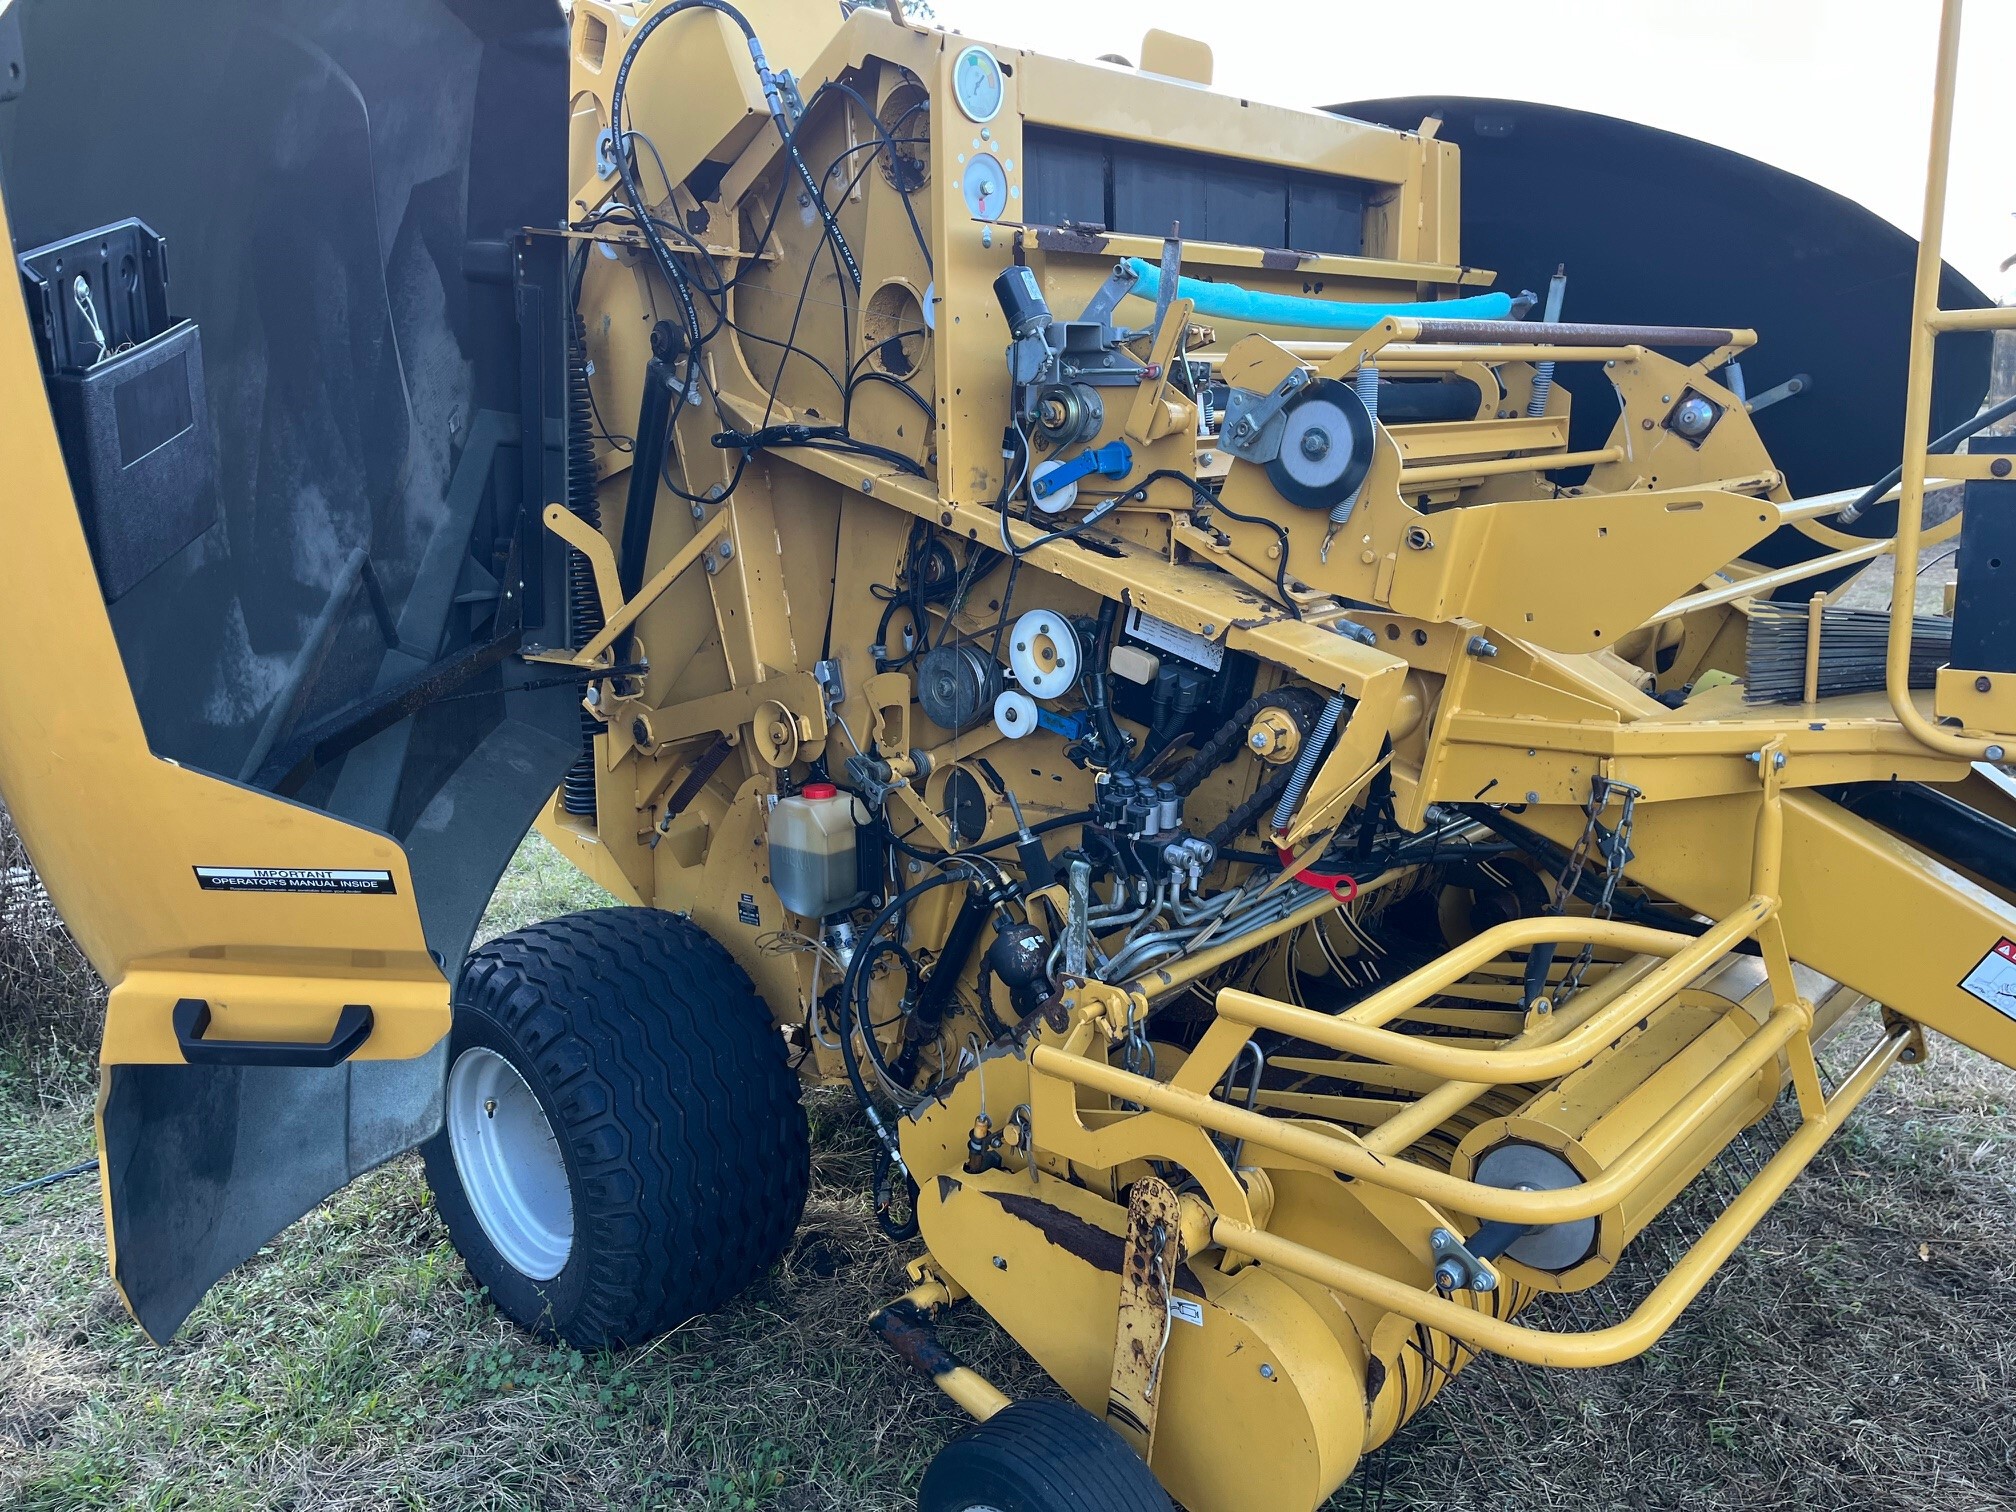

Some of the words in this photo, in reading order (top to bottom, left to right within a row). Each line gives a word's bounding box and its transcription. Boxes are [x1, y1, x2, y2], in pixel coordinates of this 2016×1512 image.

[688, 306, 698, 338] HANSA-FLEX
[253, 870, 333, 879] IMPORTANT
[212, 877, 287, 887] OPERATOR'S
[289, 879, 338, 888] MANUAL
[340, 880, 379, 888] INSIDE
